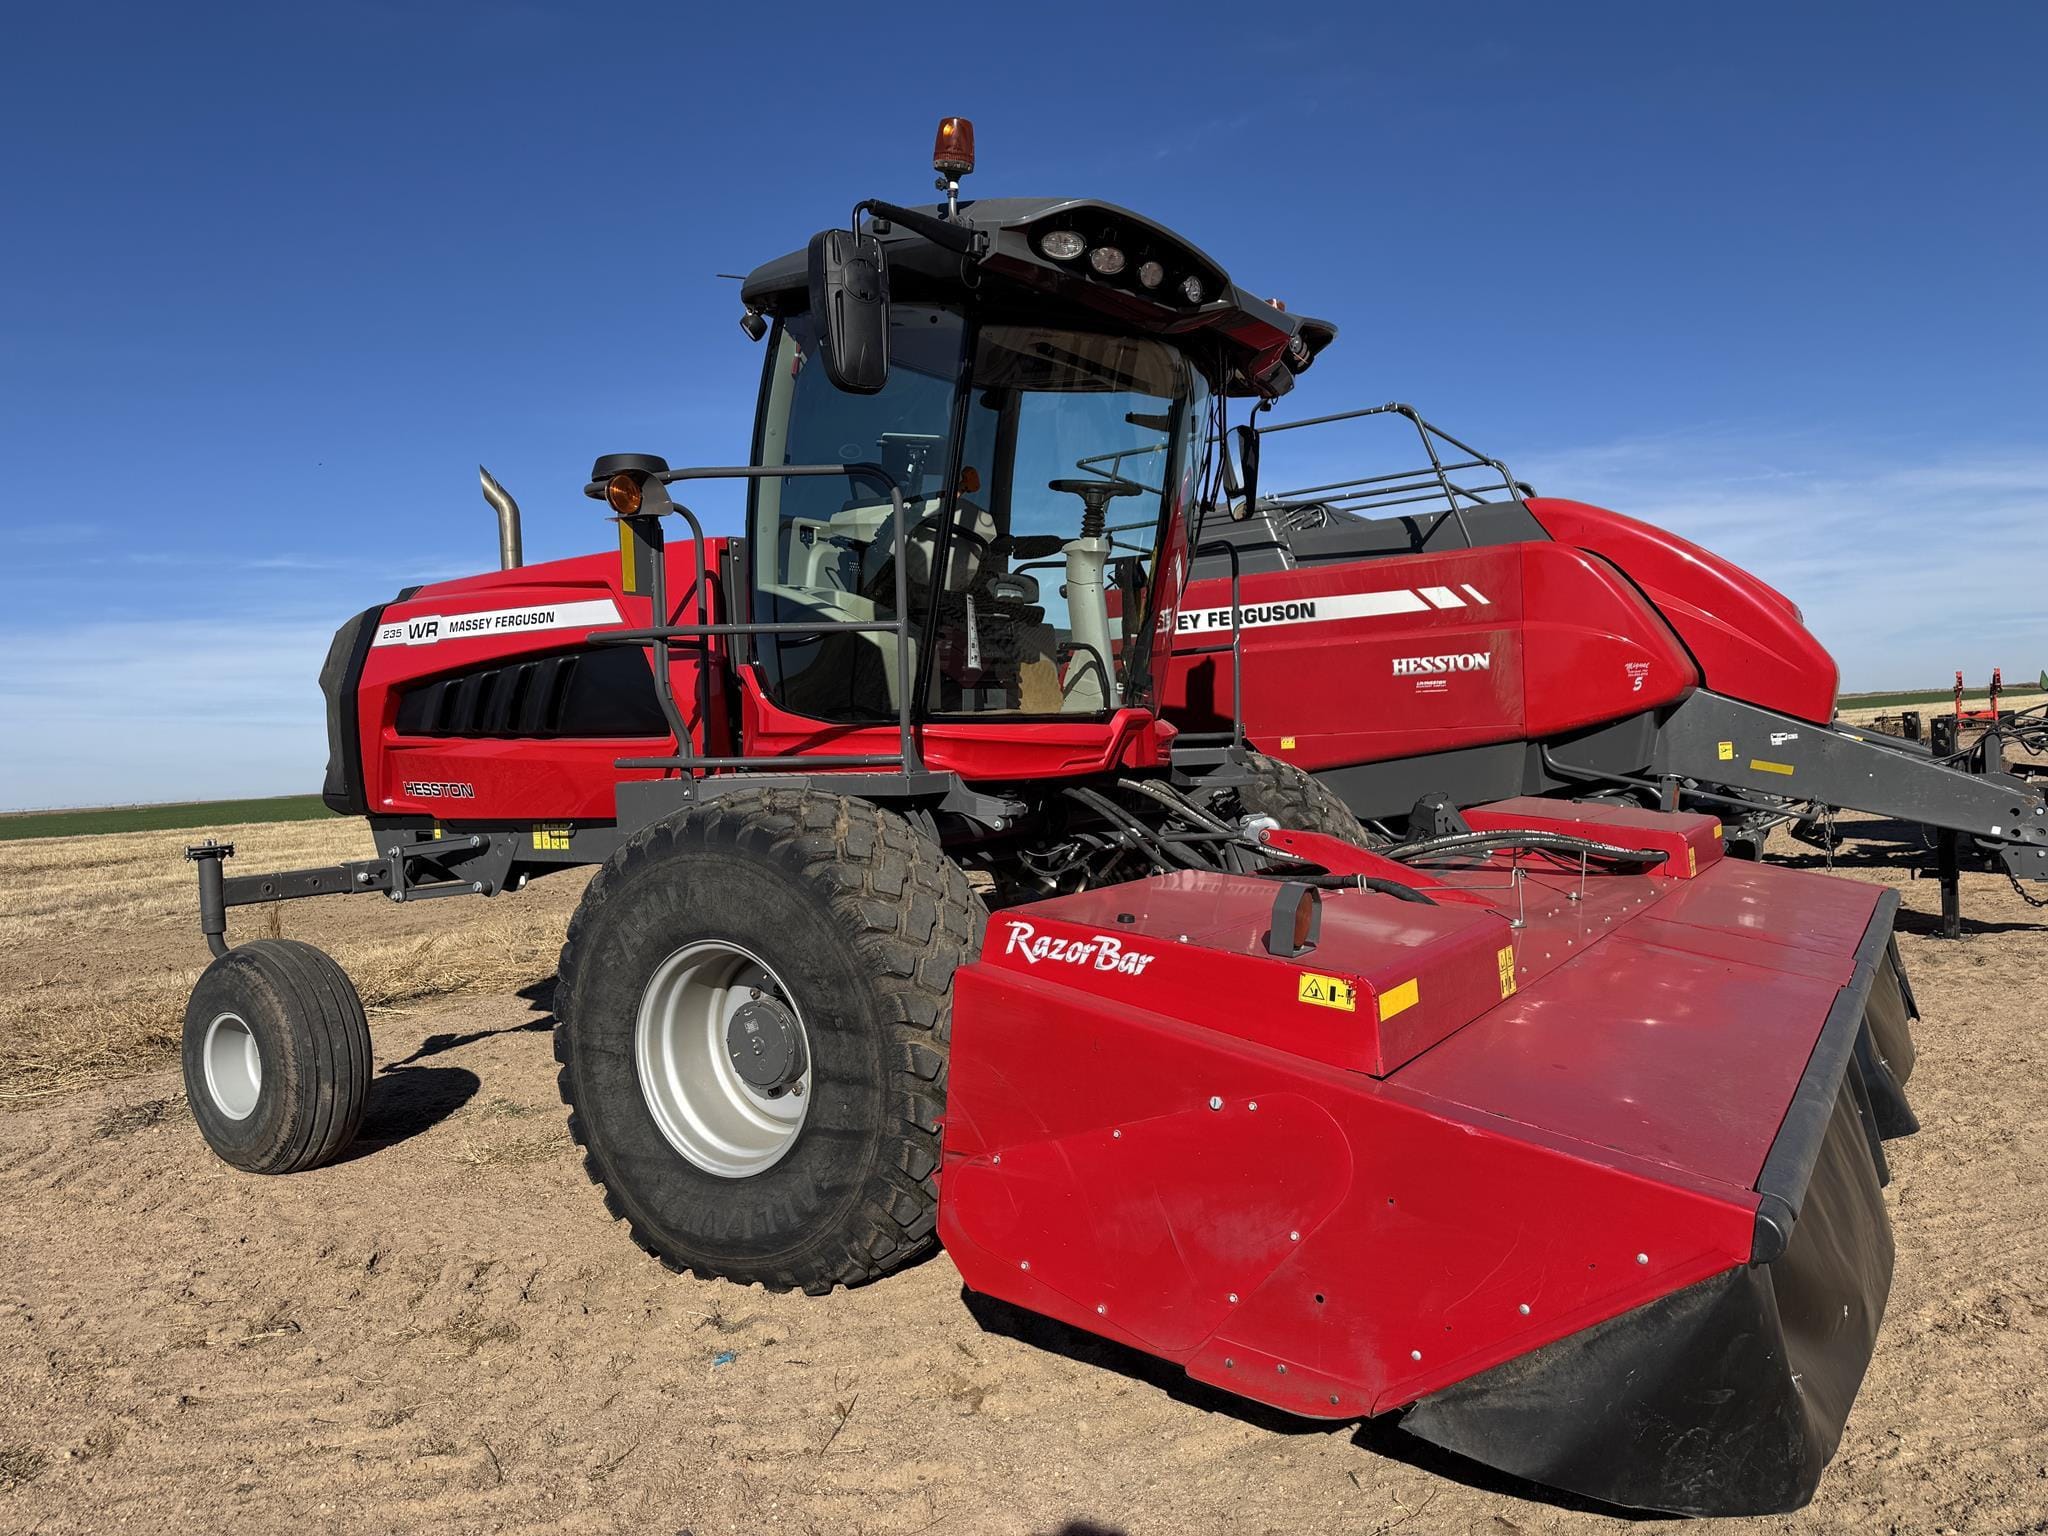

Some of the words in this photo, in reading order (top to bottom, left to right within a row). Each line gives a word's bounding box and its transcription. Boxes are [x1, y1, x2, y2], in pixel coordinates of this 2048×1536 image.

[383, 628, 402, 640] 235
[408, 621, 439, 640] WR
[449, 617, 492, 633] MASSEY
[494, 611, 555, 628] FERGUSON
[1392, 652, 1490, 677] HESSTON
[1633, 676, 1643, 691] 5
[403, 781, 475, 798] HESSTON
[1005, 921, 1155, 976] RazorBar
